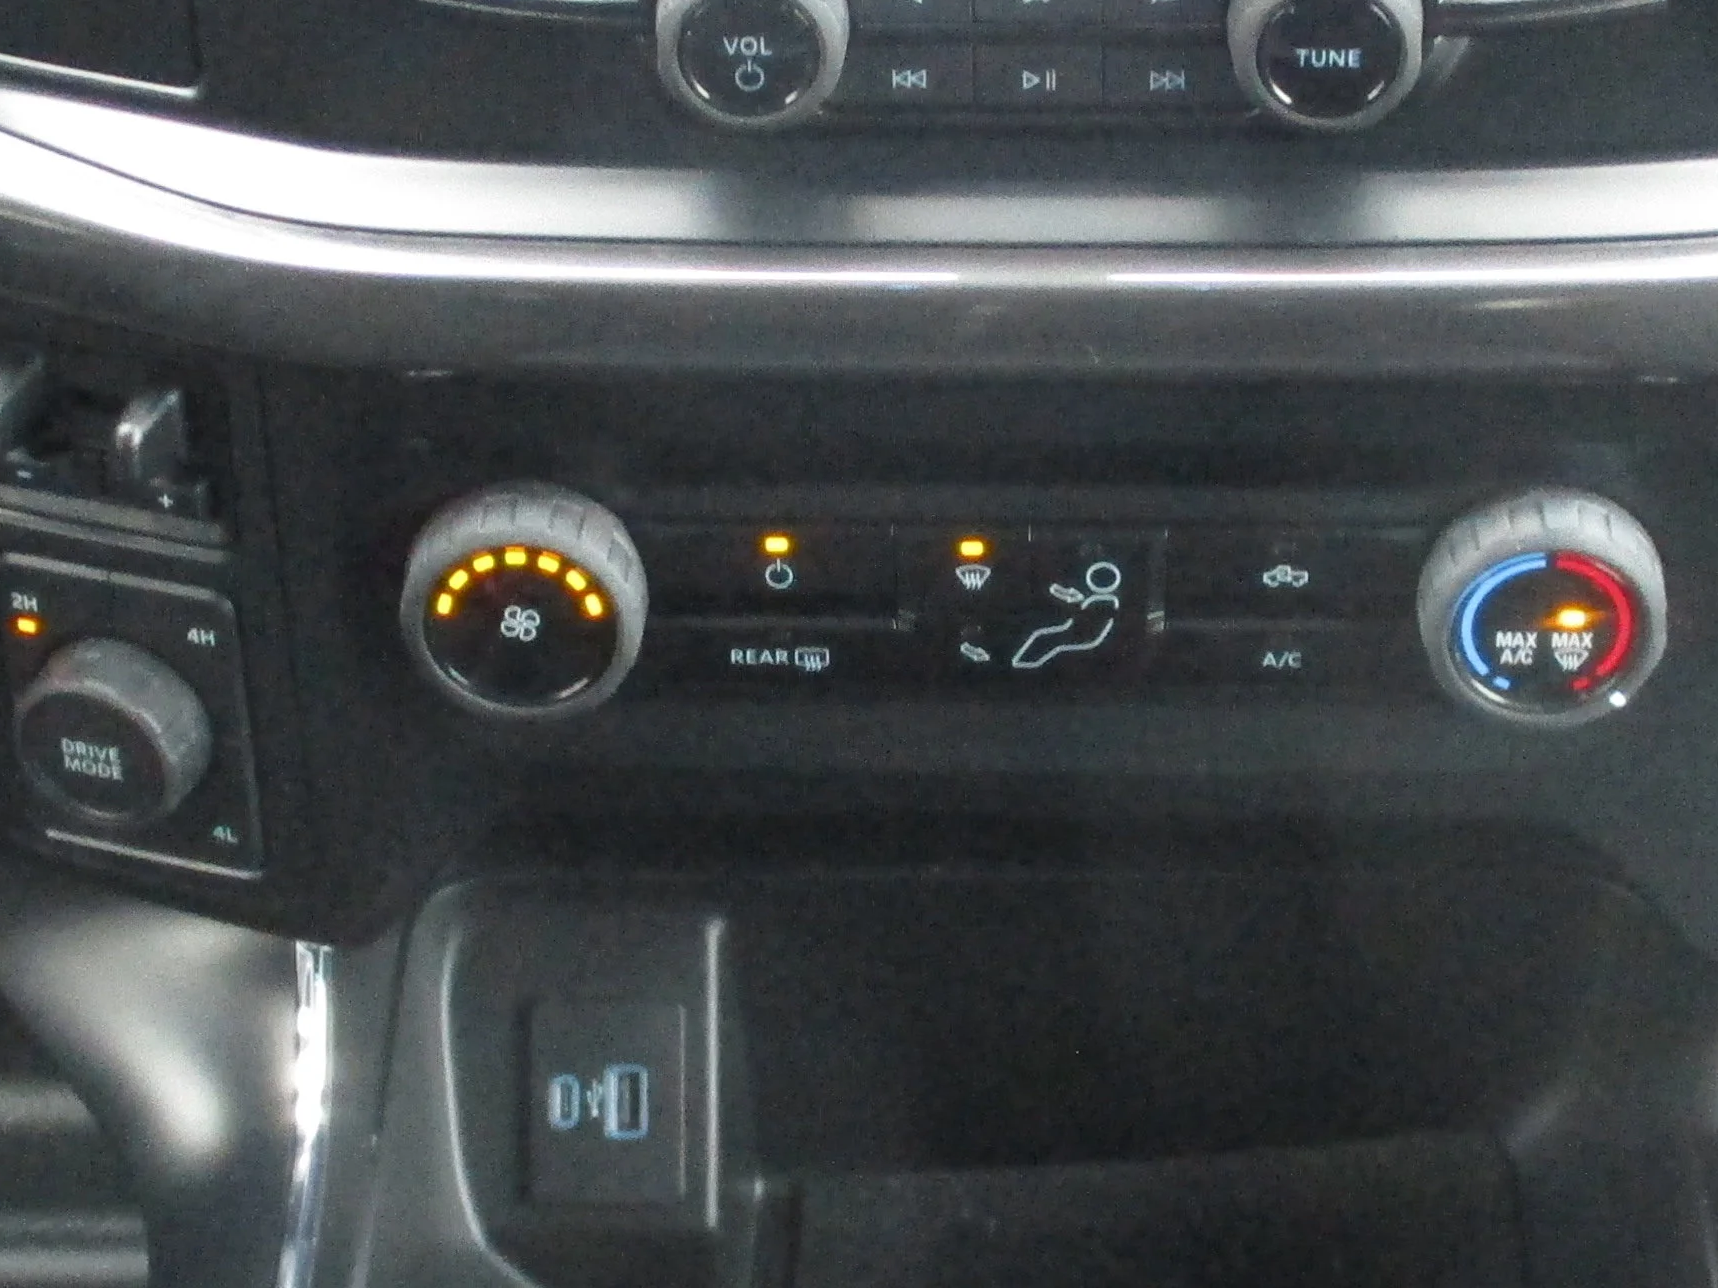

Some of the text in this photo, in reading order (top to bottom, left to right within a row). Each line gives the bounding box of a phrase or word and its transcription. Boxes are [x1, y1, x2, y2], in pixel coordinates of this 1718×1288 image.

[723, 37, 773, 57] VOL
[1295, 48, 1362, 69] TUNE
[11, 592, 38, 612] 2H
[187, 627, 216, 646] 4H
[1495, 631, 1538, 650] MAX
[1550, 631, 1594, 650] MAX
[730, 648, 789, 666] REAR
[1262, 651, 1302, 669] A/C
[1499, 648, 1534, 667] A/C
[60, 737, 121, 763] DRIVE
[63, 755, 123, 781] MODE
[212, 825, 238, 844] 4L
